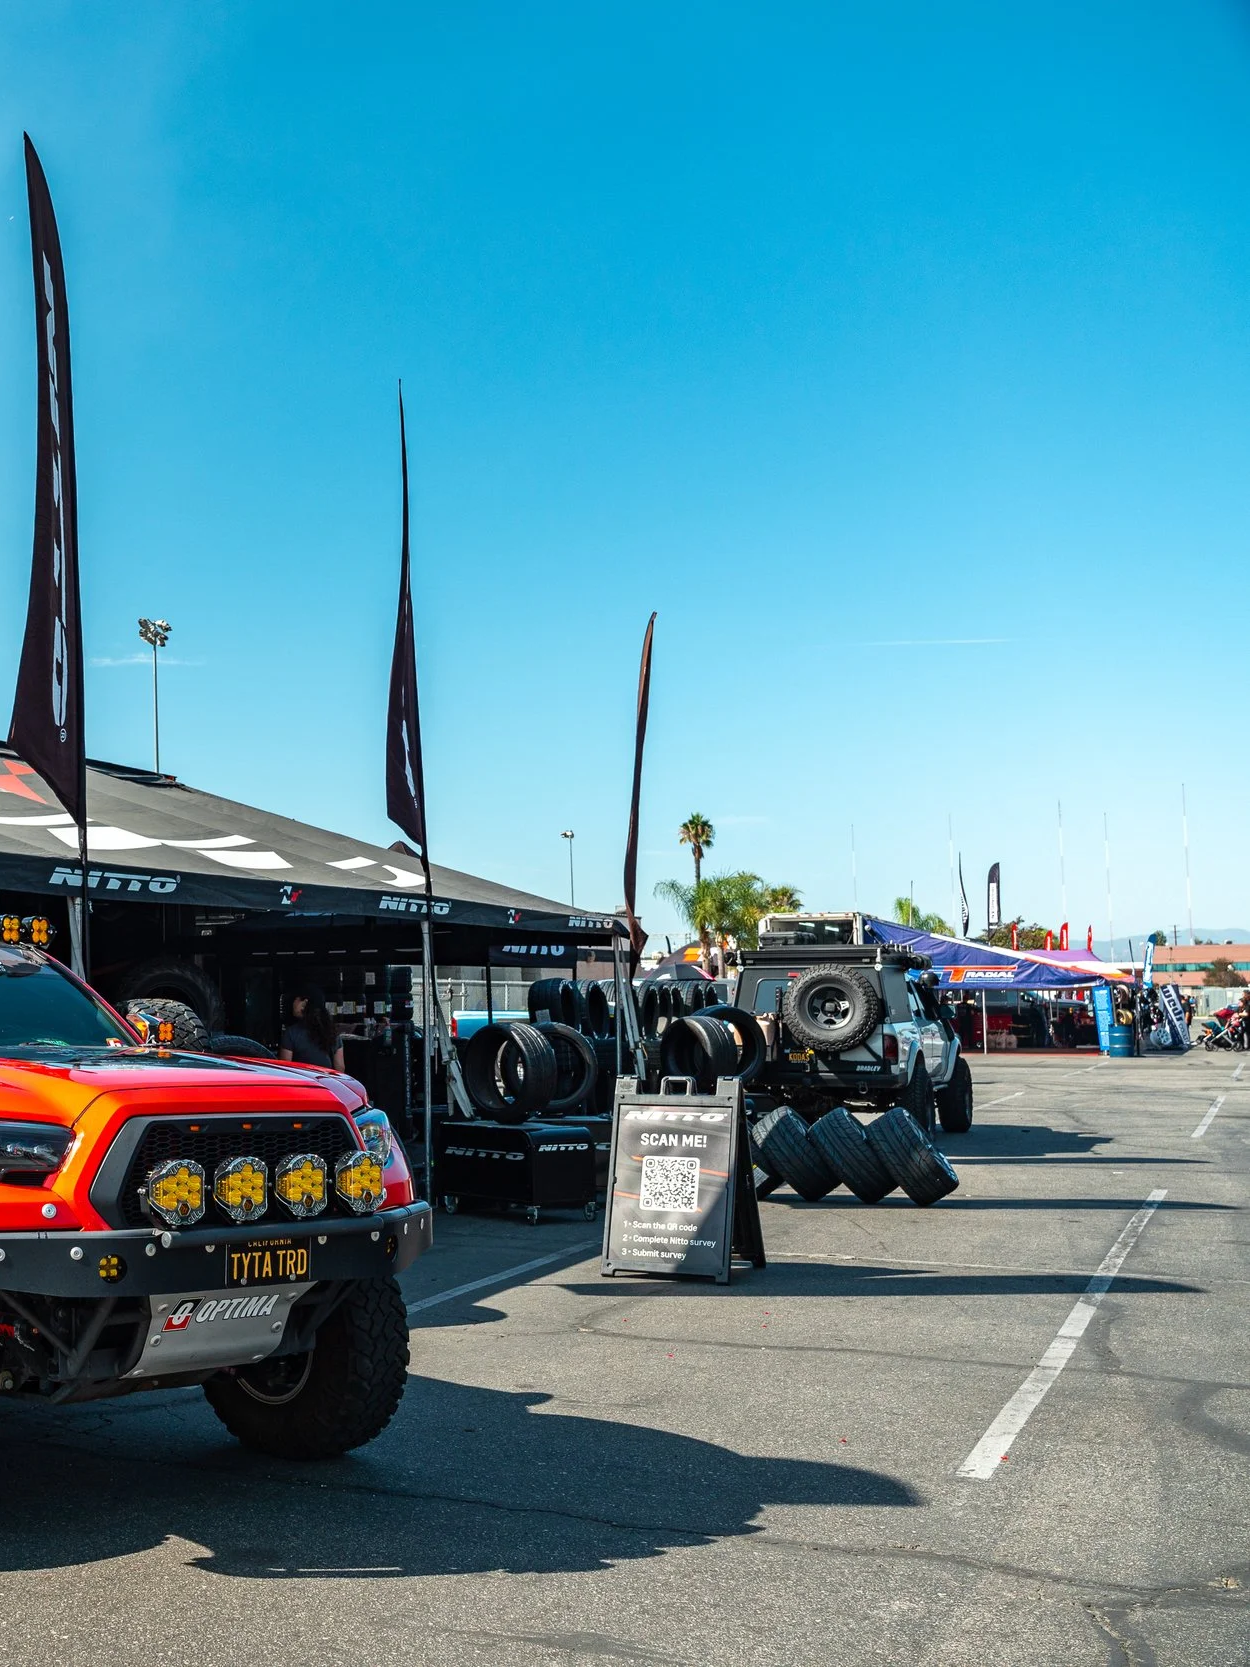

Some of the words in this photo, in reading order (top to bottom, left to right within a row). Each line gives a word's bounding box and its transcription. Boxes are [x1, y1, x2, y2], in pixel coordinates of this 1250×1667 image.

[48, 866, 179, 894] NITTO
[378, 895, 451, 915] NITTO
[568, 916, 613, 929] NITTO
[623, 1111, 725, 1122] NITTO
[538, 1143, 589, 1152] NITTO
[640, 1133, 678, 1147] SCAN
[682, 1135, 707, 1148] ME!
[444, 1146, 526, 1161] NITTO
[632, 1221, 651, 1230] Scan
[653, 1222, 666, 1231] the
[667, 1223, 678, 1232] QR
[679, 1223, 698, 1232] code
[633, 1234, 669, 1245] Complete
[670, 1236, 689, 1246] Nitto
[690, 1238, 716, 1248] survey
[632, 1249, 659, 1258] Submit
[661, 1251, 687, 1260] survey
[231, 1252, 272, 1280] TYTA
[277, 1249, 307, 1276] TRD
[195, 1294, 280, 1323] OPTIMA
